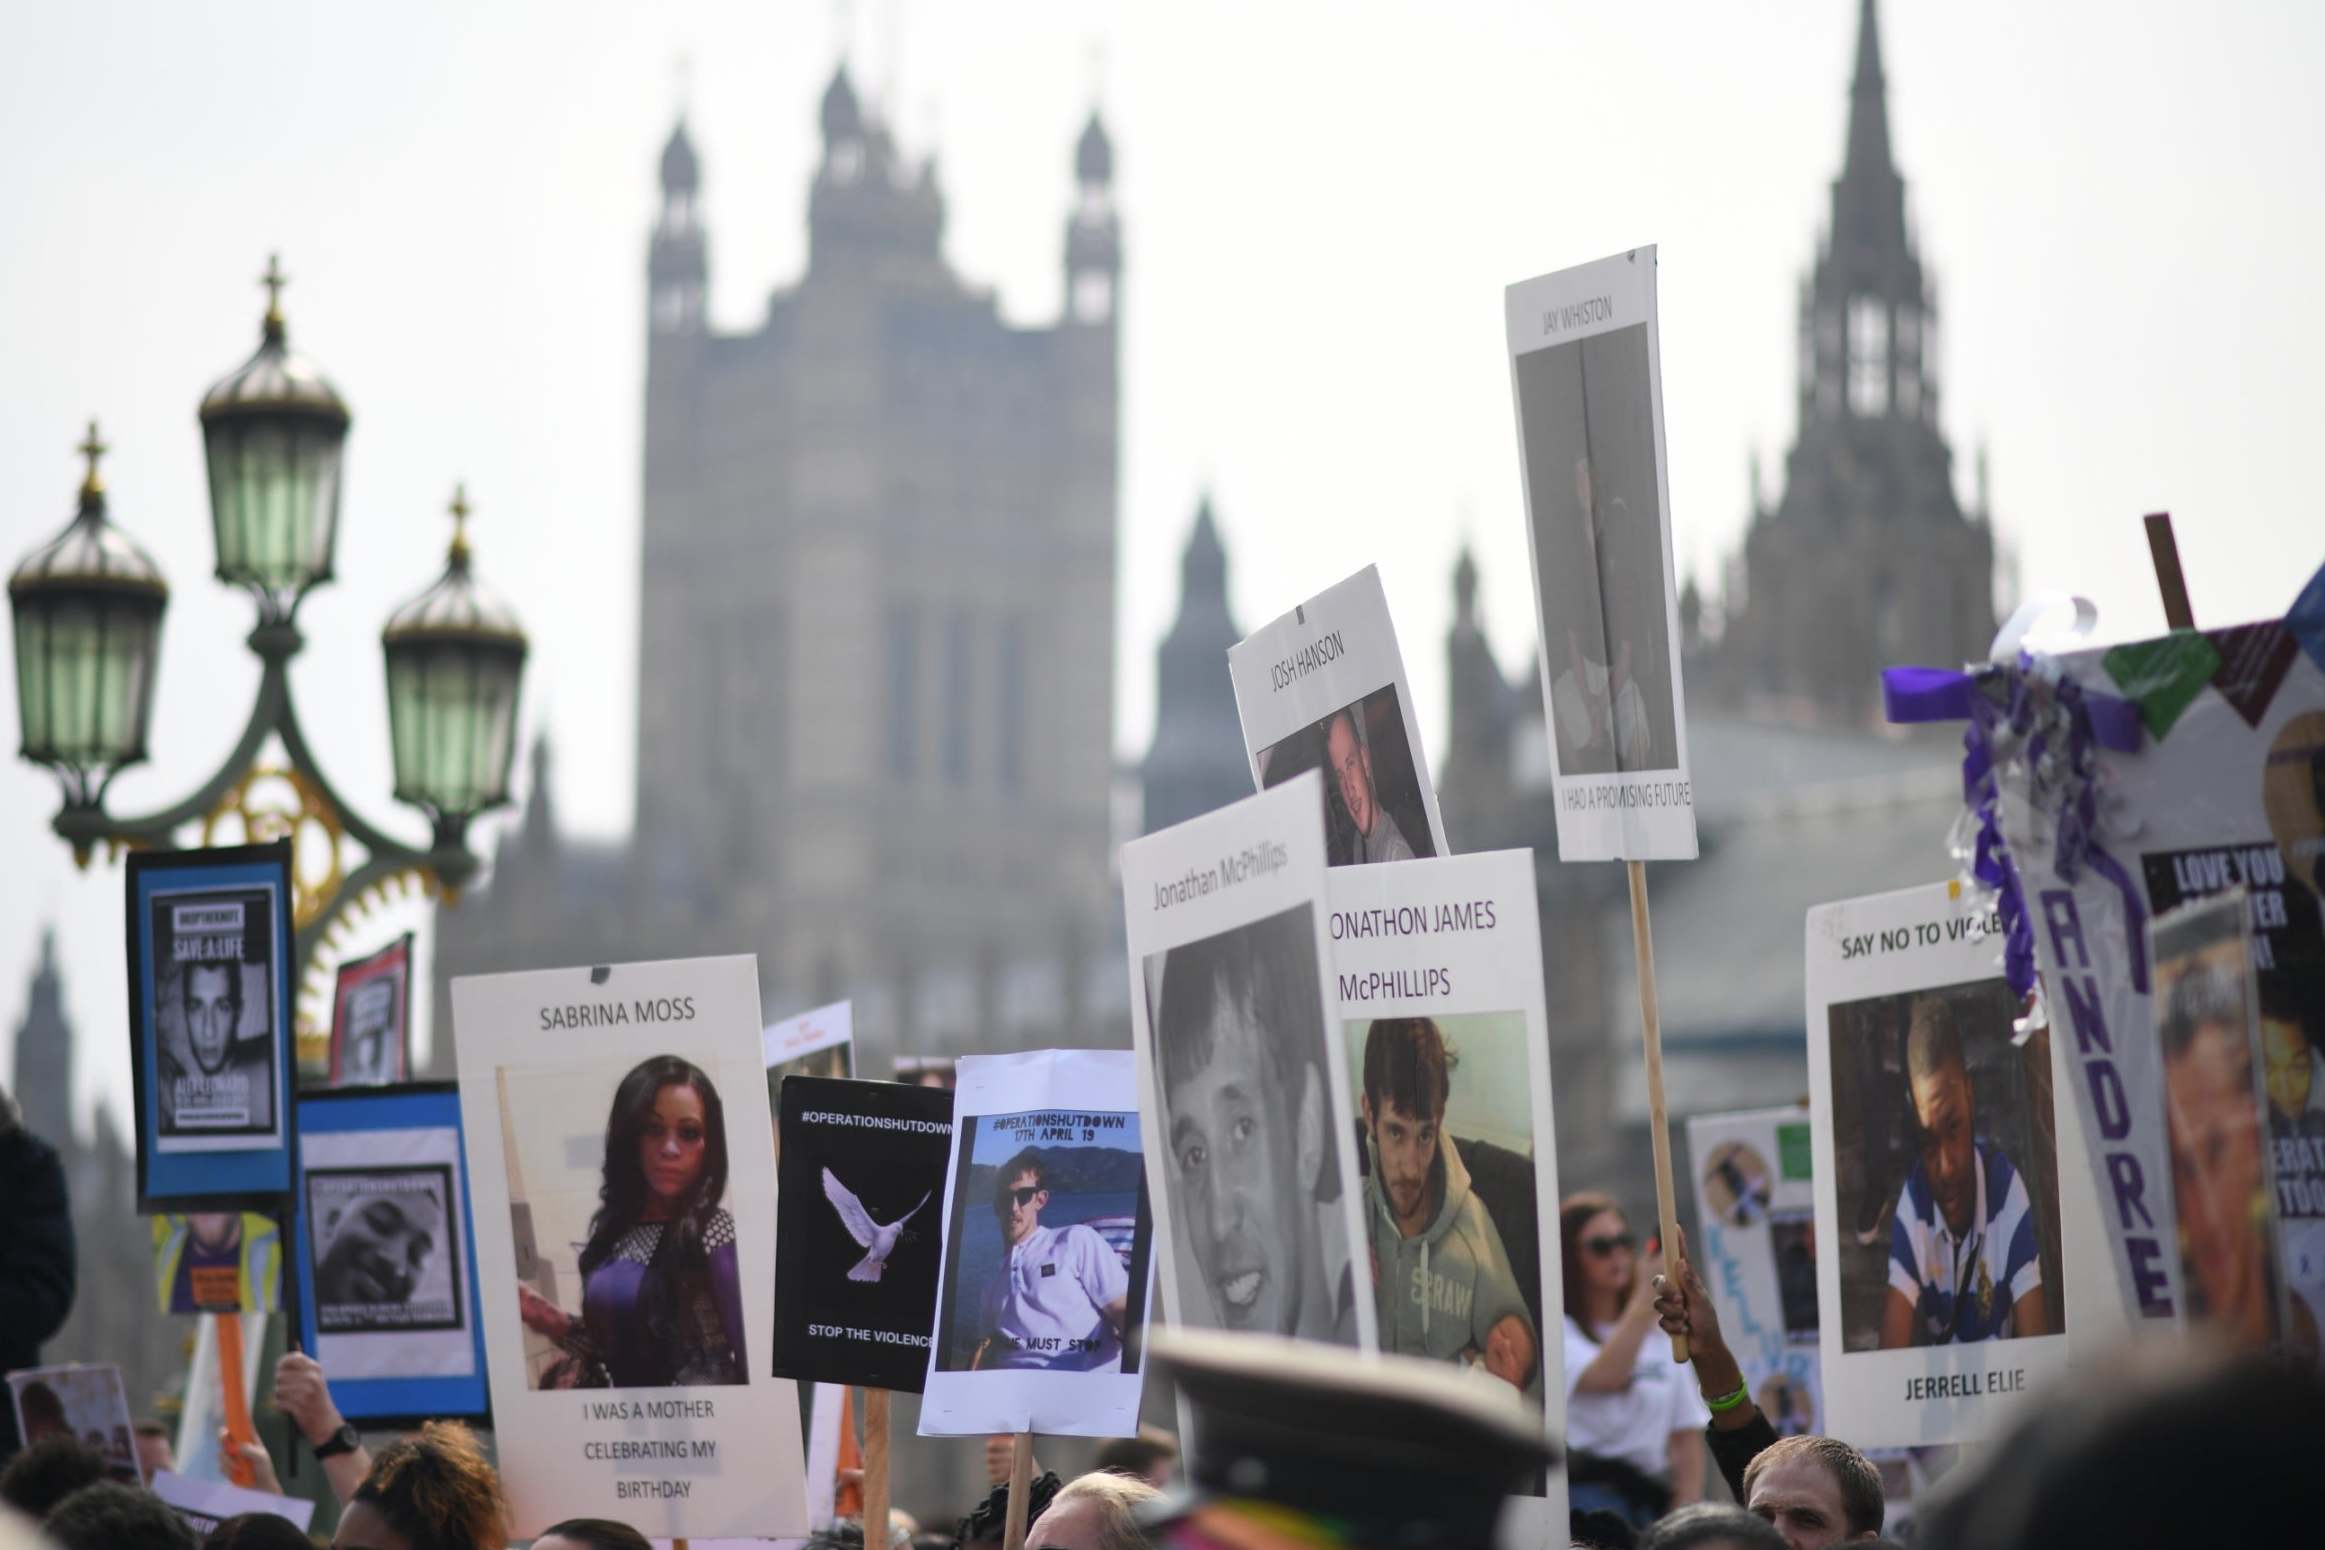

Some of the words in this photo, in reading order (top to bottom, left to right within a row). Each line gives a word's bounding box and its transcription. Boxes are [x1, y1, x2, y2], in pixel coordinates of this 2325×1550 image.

[1560, 295, 1613, 330] WHISTON
[1271, 656, 1297, 692] JOSH
[1296, 630, 1344, 678] HANSON
[1568, 786, 1586, 810] HAD
[1588, 786, 1596, 808] A
[1654, 782, 1692, 806] FUTURE
[1153, 867, 1218, 912] Jonathan
[1220, 840, 1289, 888] McPhillips
[2173, 852, 2232, 892] LOVE
[2232, 848, 2286, 888] YOU
[1330, 905, 1427, 940] ONATHON
[1433, 900, 1496, 933] JAMES
[1842, 933, 1874, 960] SAY
[1881, 928, 1910, 952] NO
[1915, 922, 1940, 947] TO
[1339, 968, 1451, 1001] McPHILLIPS
[540, 1002, 629, 1031] SABRINA
[635, 996, 696, 1024] MOSS
[2040, 890, 2174, 1318] ANDRE
[801, 1111, 954, 1135] #OPERATIONSHUTDOWN
[993, 1112, 1126, 1131] #OPERATIONSHUTDOWN
[1015, 1129, 1035, 1142] 17TH
[1040, 1128, 1074, 1142] APRIL
[1082, 1129, 1095, 1142] 19
[808, 1323, 843, 1338] STOP
[846, 1327, 872, 1341] THE
[874, 1331, 935, 1348] VIOLENCE
[1025, 1337, 1061, 1351] MUST
[1905, 1374, 1982, 1401] JERRELL
[1988, 1369, 2025, 1393] ELIE
[583, 1403, 588, 1420] I
[592, 1402, 628, 1420] WAS
[632, 1402, 644, 1419] A
[647, 1400, 715, 1418] MOTHER
[584, 1440, 687, 1460] CELEBRATING
[692, 1439, 716, 1458] MY
[617, 1481, 691, 1499] BIRTHDAY
